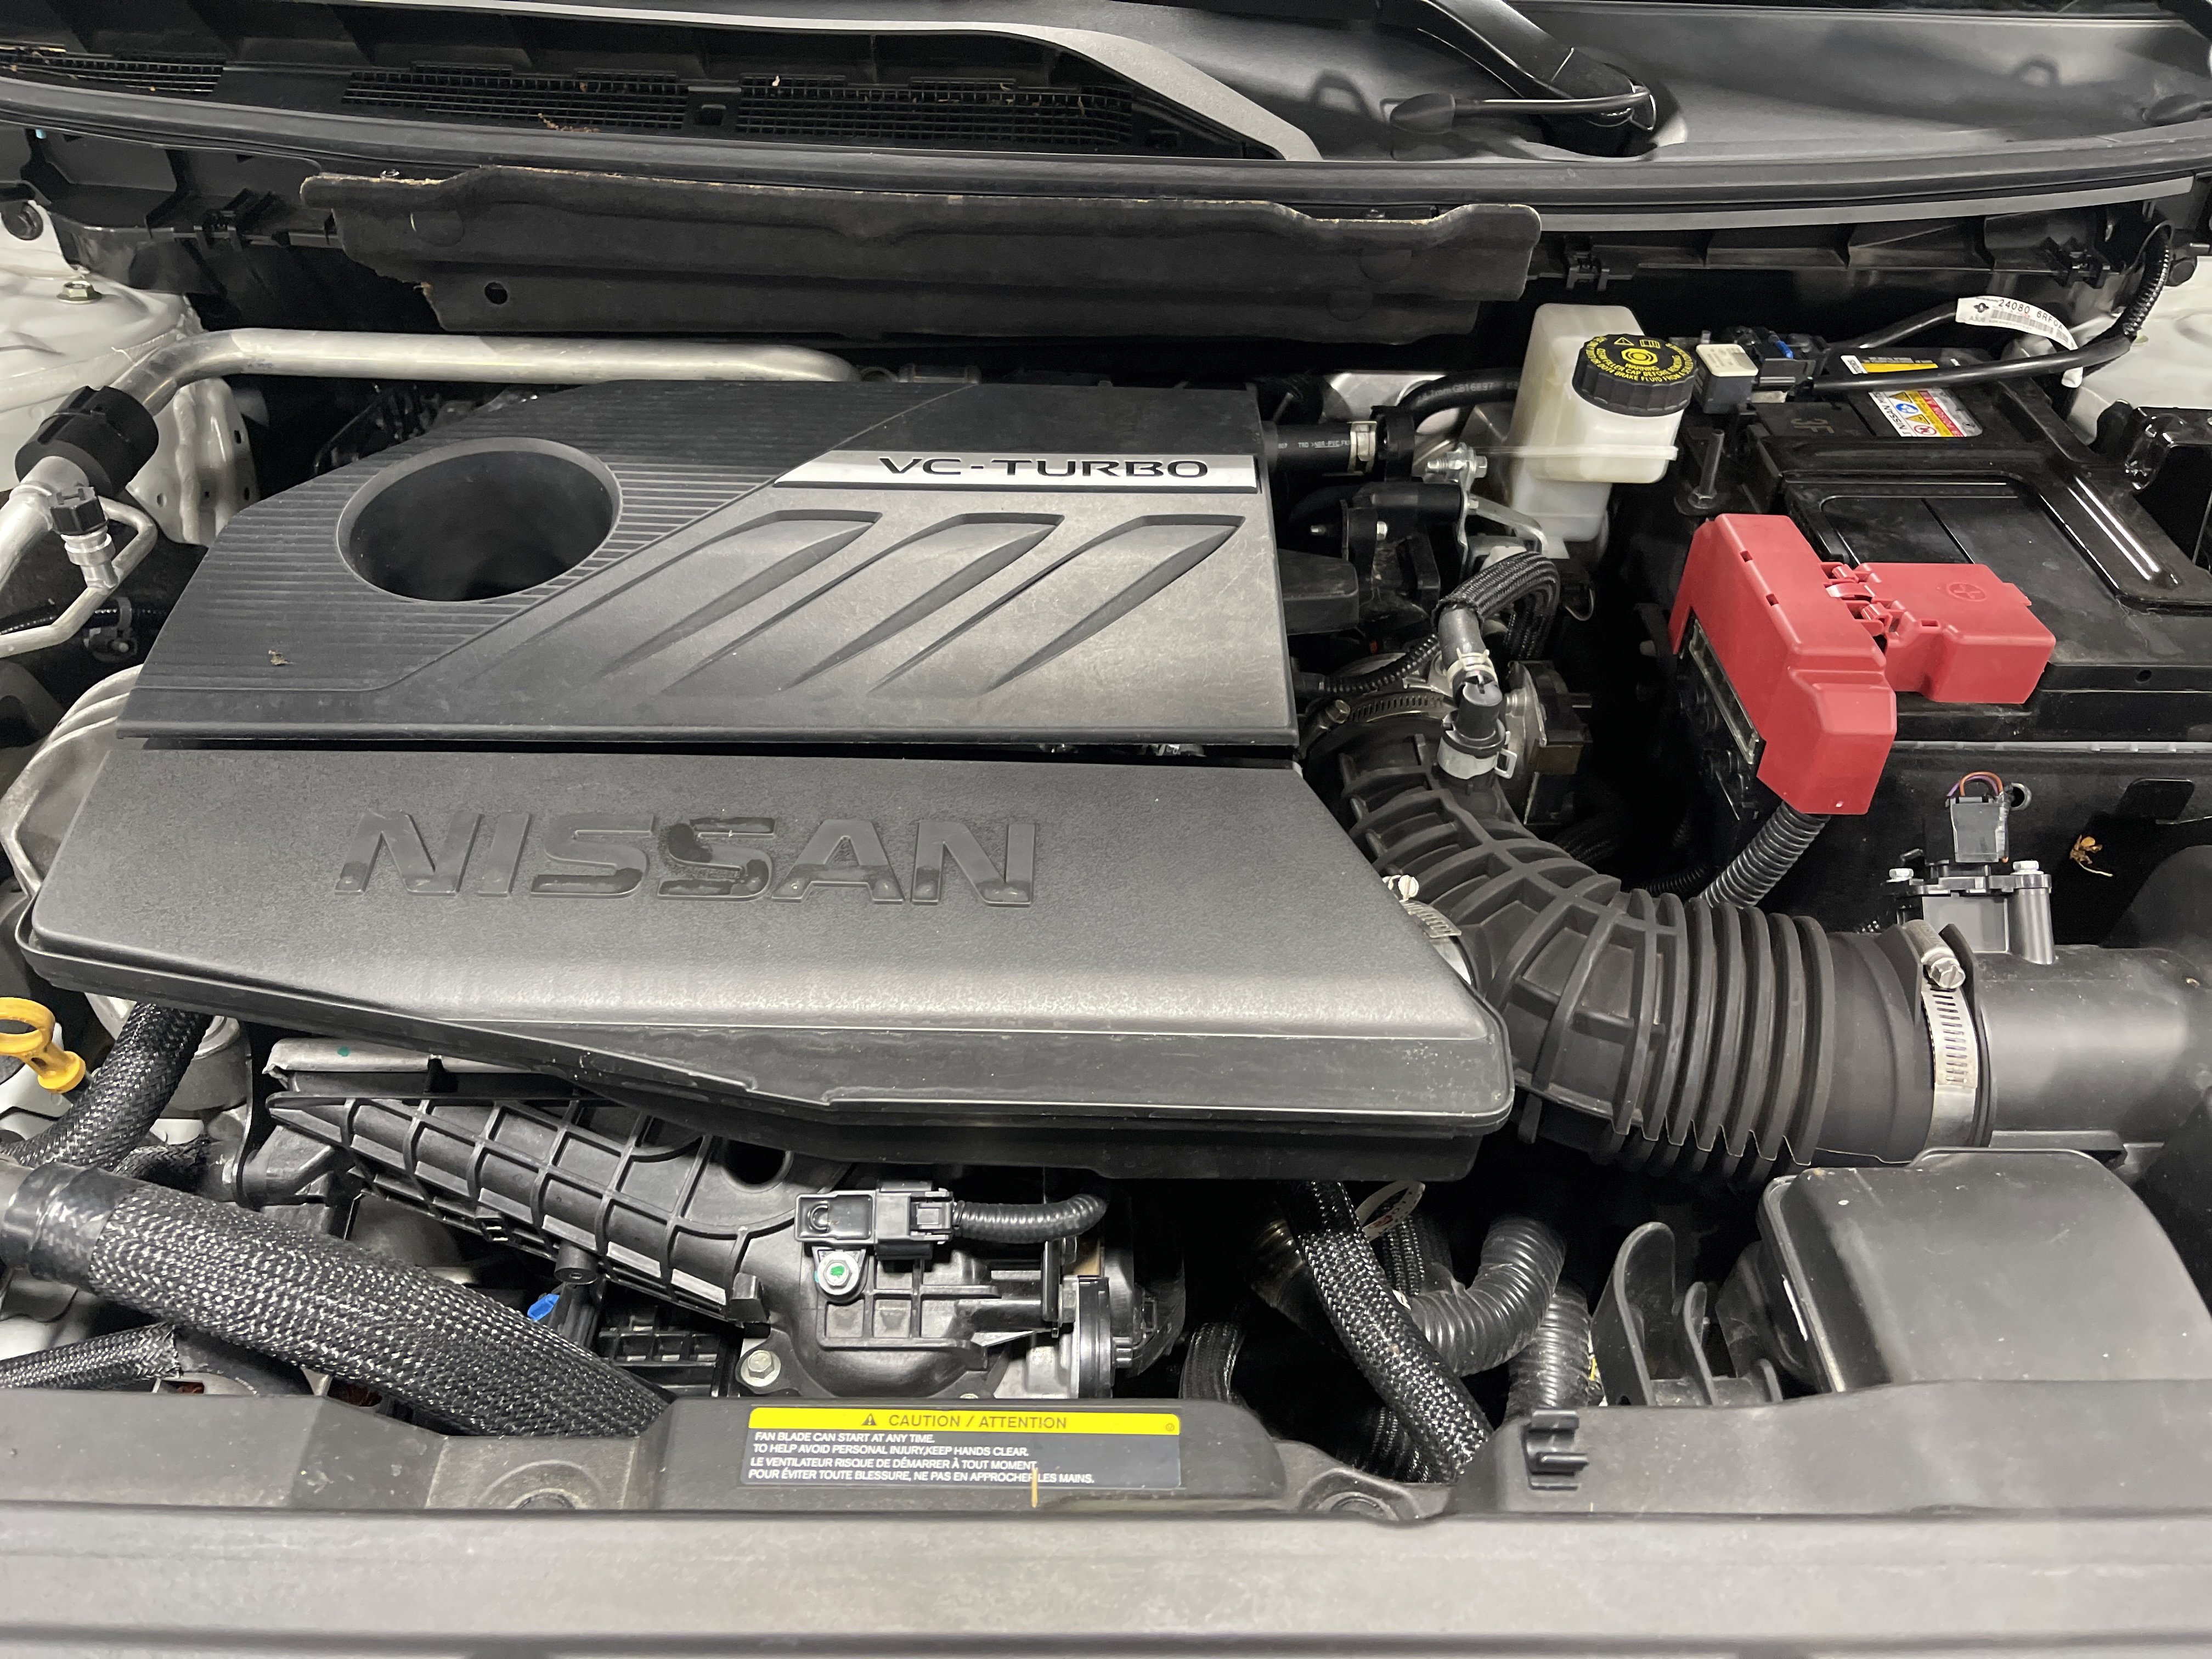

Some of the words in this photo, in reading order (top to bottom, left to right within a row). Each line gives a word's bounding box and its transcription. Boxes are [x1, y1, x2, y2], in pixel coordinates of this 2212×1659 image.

[1999, 299, 2030, 314] 24080
[1625, 363, 1660, 371] WARNING
[1615, 371, 1639, 381] BRAKE
[335, 810, 1036, 907] NISSAN
[889, 1414, 960, 1427] CAUTION
[978, 1416, 1068, 1429] ATTENTION
[755, 1431, 776, 1441] FAN
[777, 1432, 812, 1441] BLADE
[813, 1432, 836, 1442] CAN
[838, 1433, 870, 1442] START
[871, 1434, 885, 1442] AT
[885, 1434, 909, 1443] ANY
[753, 1443, 768, 1453] TO
[770, 1443, 797, 1453] HELP
[798, 1444, 830, 1453] AVOID
[832, 1444, 888, 1454] PERSONAL
[954, 1447, 990, 1456] HANDS
[751, 1457, 764, 1466] LE
[766, 1457, 833, 1467] VENTILATEUR
[834, 1458, 874, 1468] RISQUE
[876, 1459, 891, 1468] DE
[893, 1457, 950, 1469] DÉMARRER
[951, 1457, 960, 1469] À
[962, 1460, 990, 1469] TOUT
[748, 1469, 780, 1479] POUR
[781, 1467, 817, 1480] ÉVITER
[819, 1470, 853, 1480] TOUTE
[913, 1471, 929, 1481] NE
[930, 1471, 951, 1481] PAS
[953, 1472, 968, 1481] EN
[1037, 1472, 1057, 1483] LES
[1059, 1473, 1094, 1483] MAINS.
